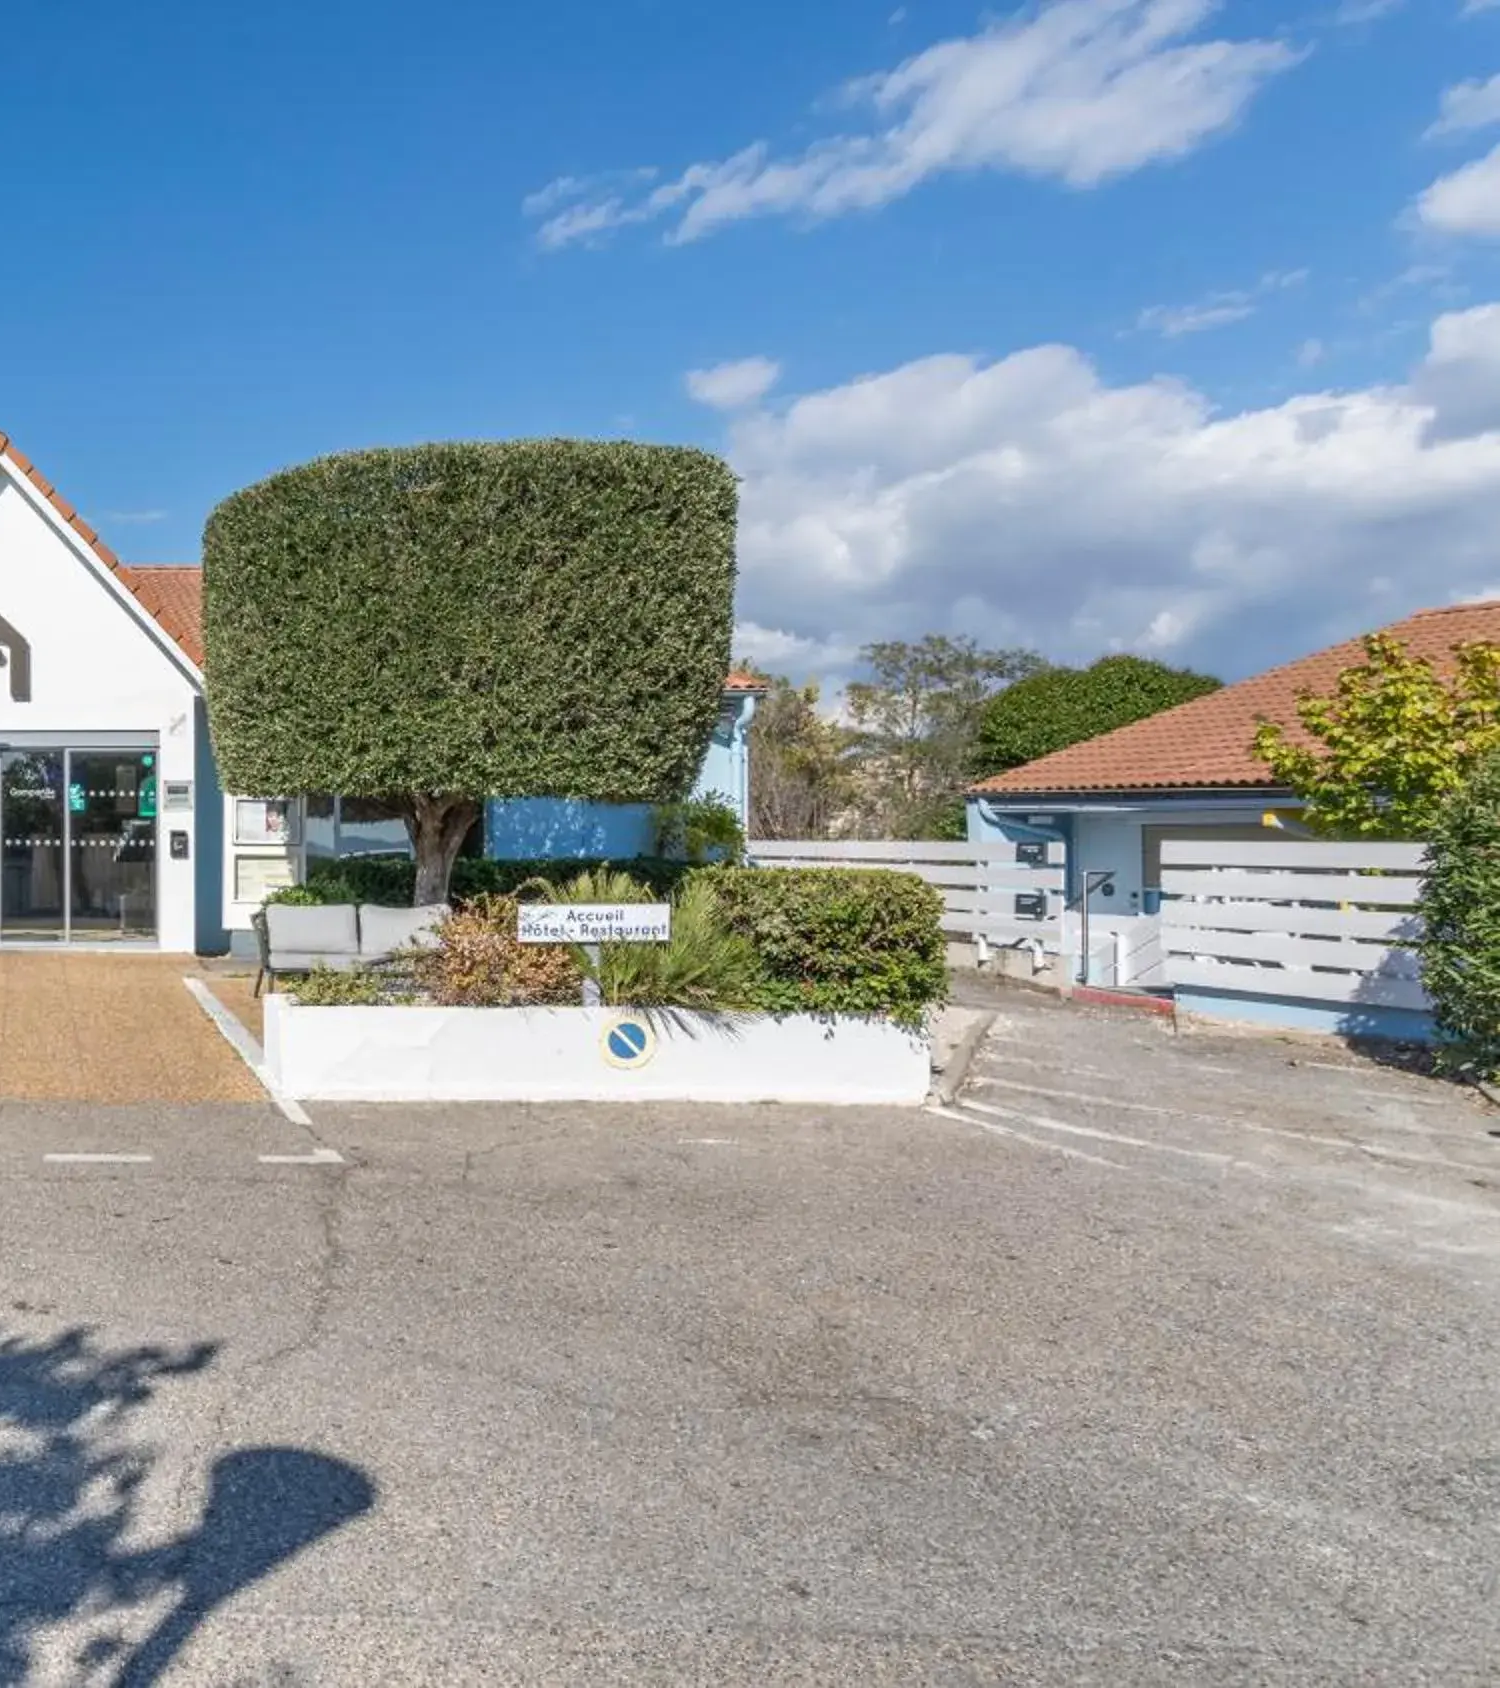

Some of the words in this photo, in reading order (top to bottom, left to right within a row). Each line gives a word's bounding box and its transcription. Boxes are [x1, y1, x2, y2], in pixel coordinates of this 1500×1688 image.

[566, 909, 625, 921] Accueil
[521, 923, 566, 937] Hôtel
[580, 923, 667, 937] Restaurant
